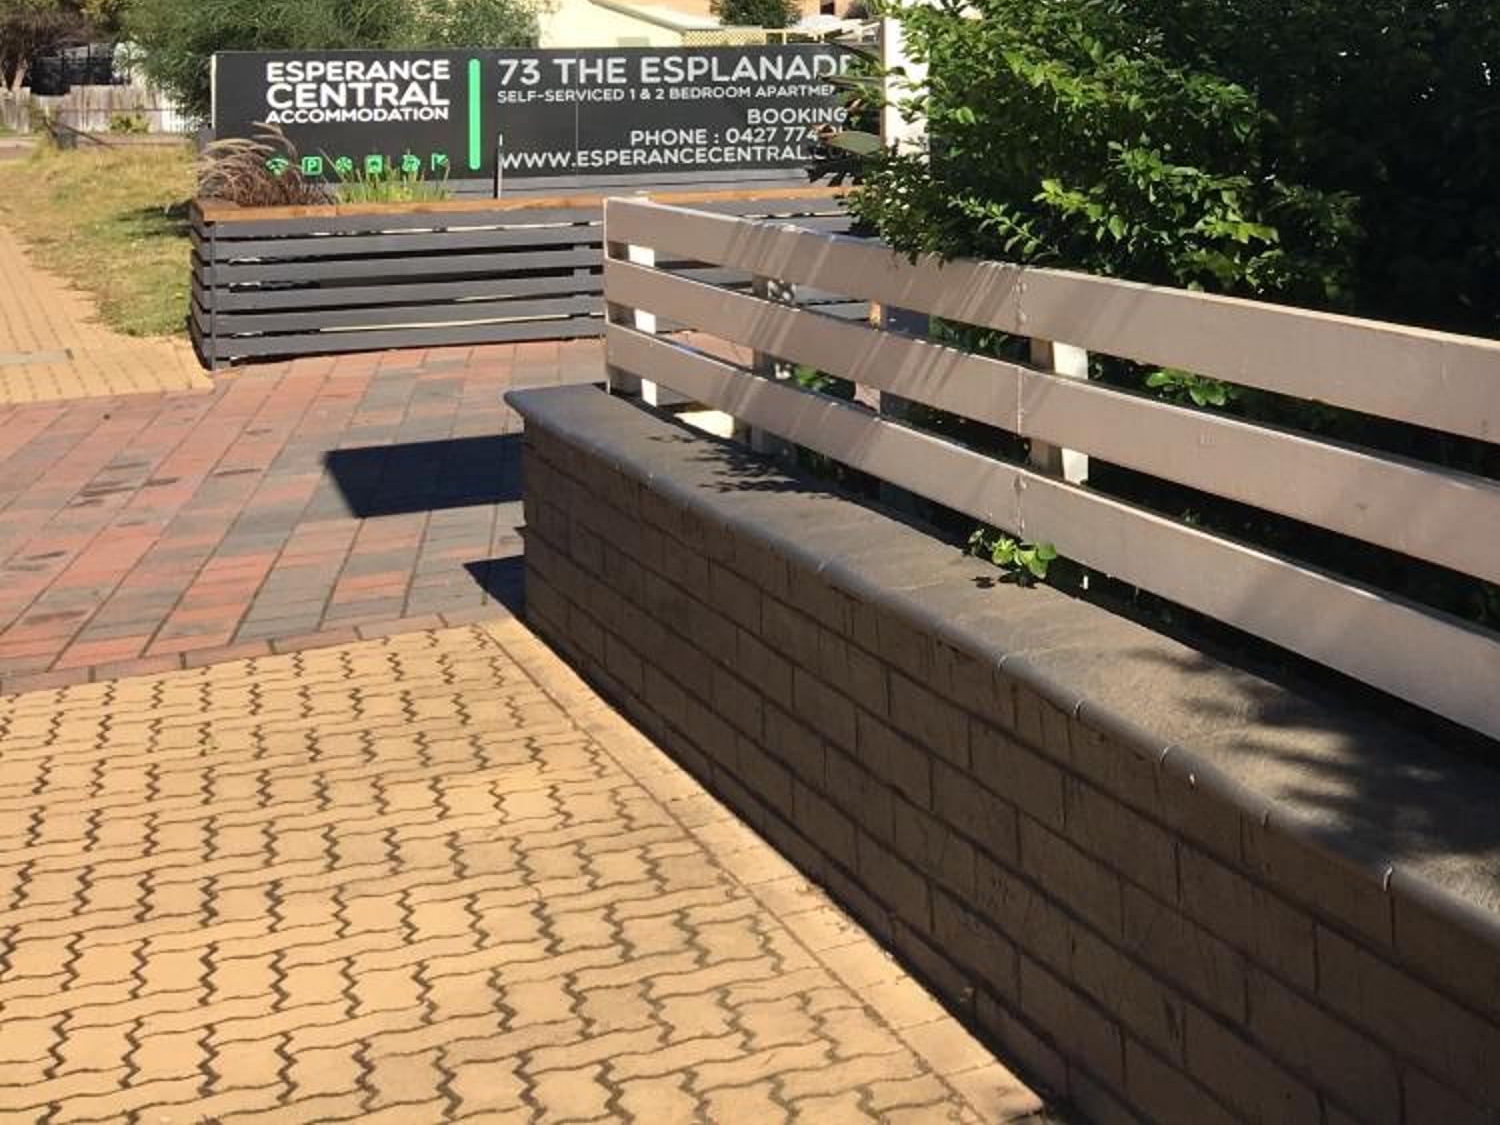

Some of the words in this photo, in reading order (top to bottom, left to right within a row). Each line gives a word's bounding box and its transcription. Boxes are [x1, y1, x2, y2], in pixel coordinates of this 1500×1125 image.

[266, 59, 450, 83] ESPERANCE
[498, 58, 541, 86] 73
[552, 57, 628, 85] THE
[265, 81, 450, 109] CENTRAL
[497, 87, 625, 103] SELF-SERVICED
[629, 88, 636, 100] 1
[639, 88, 651, 100] &
[655, 88, 665, 100] 2
[669, 86, 751, 100] BEDROOM
[265, 106, 449, 125] ACCOMMODATION
[630, 128, 708, 147] PHONE
[725, 127, 777, 144] 0427
